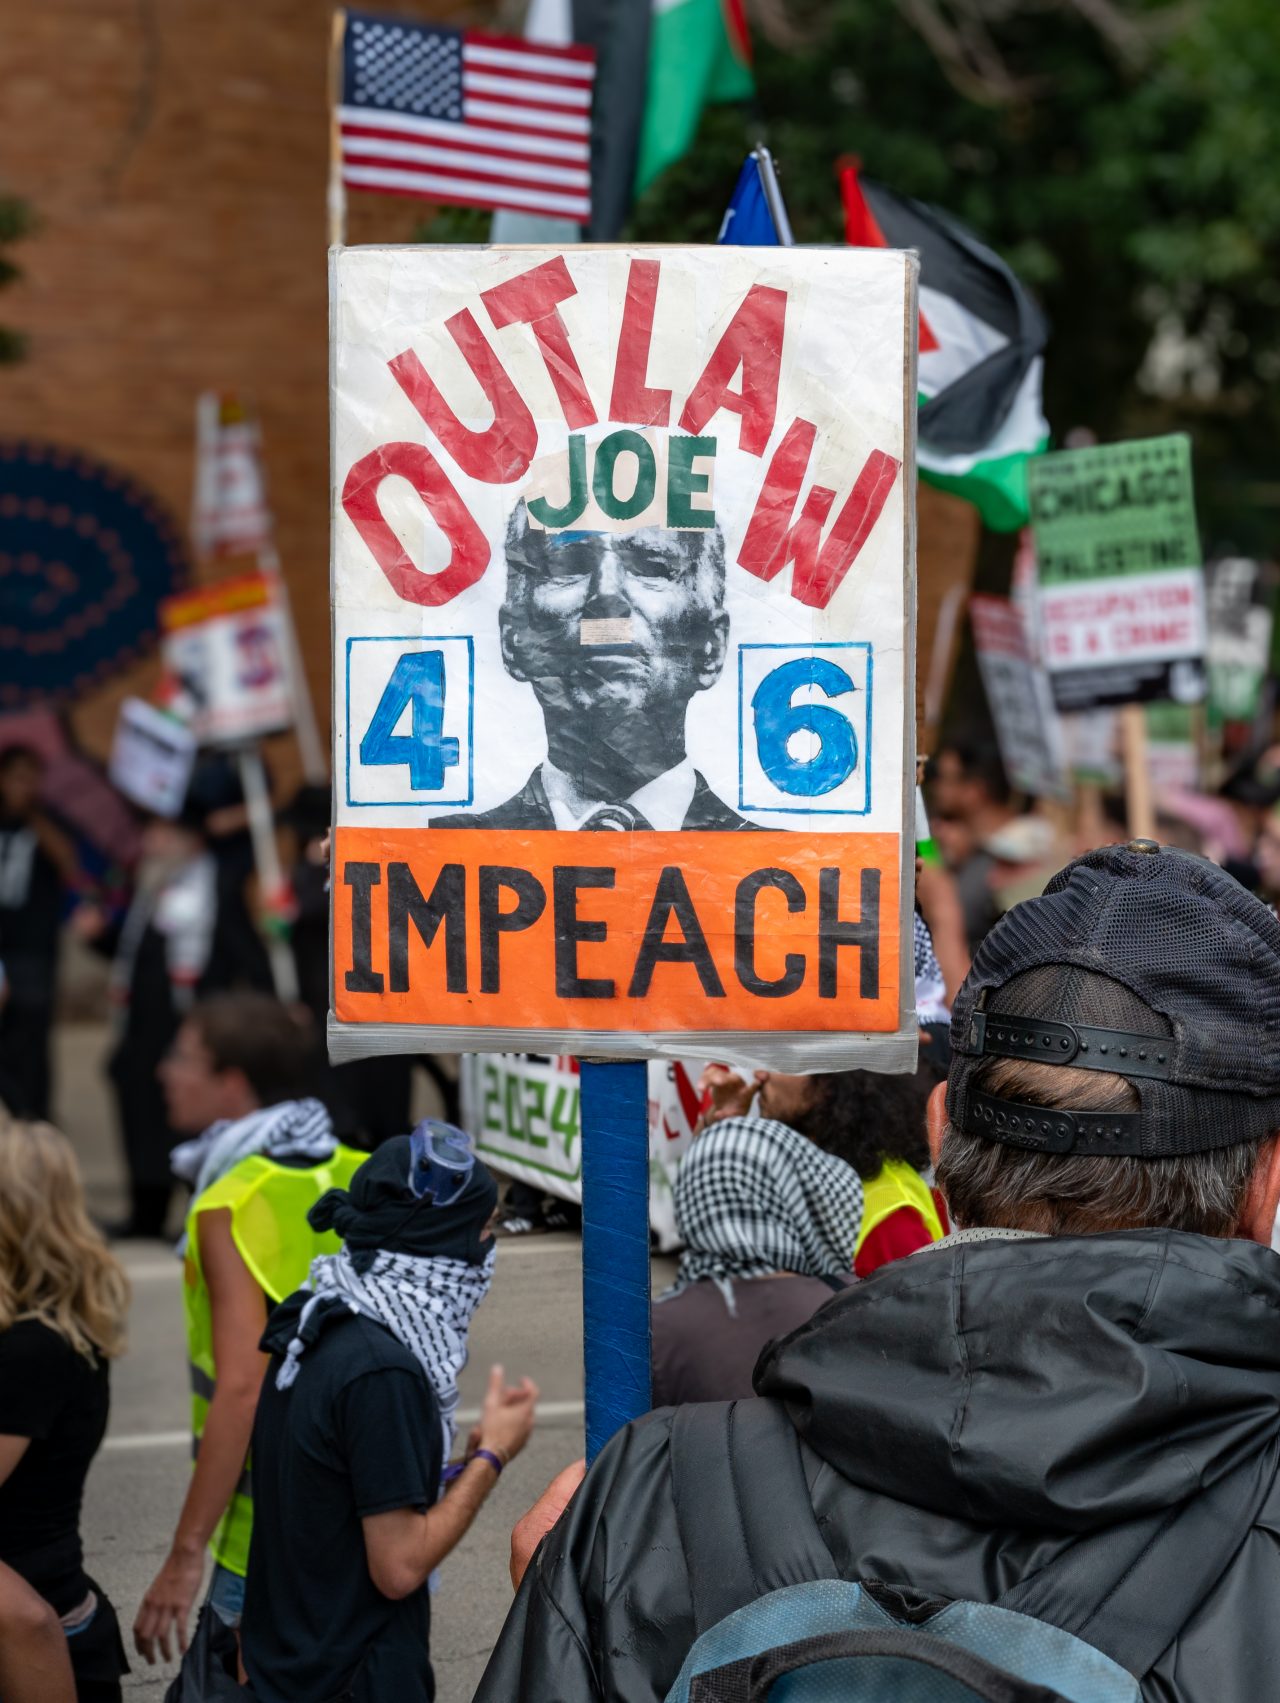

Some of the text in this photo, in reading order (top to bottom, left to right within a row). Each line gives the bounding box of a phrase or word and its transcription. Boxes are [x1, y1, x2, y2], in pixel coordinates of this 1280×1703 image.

[342, 255, 902, 609] OUTLAW
[527, 429, 717, 529] JOE
[360, 650, 459, 790] 4
[752, 656, 863, 797] 6
[344, 861, 882, 1000] IMPEACH
[484, 1062, 580, 1158] 2024
